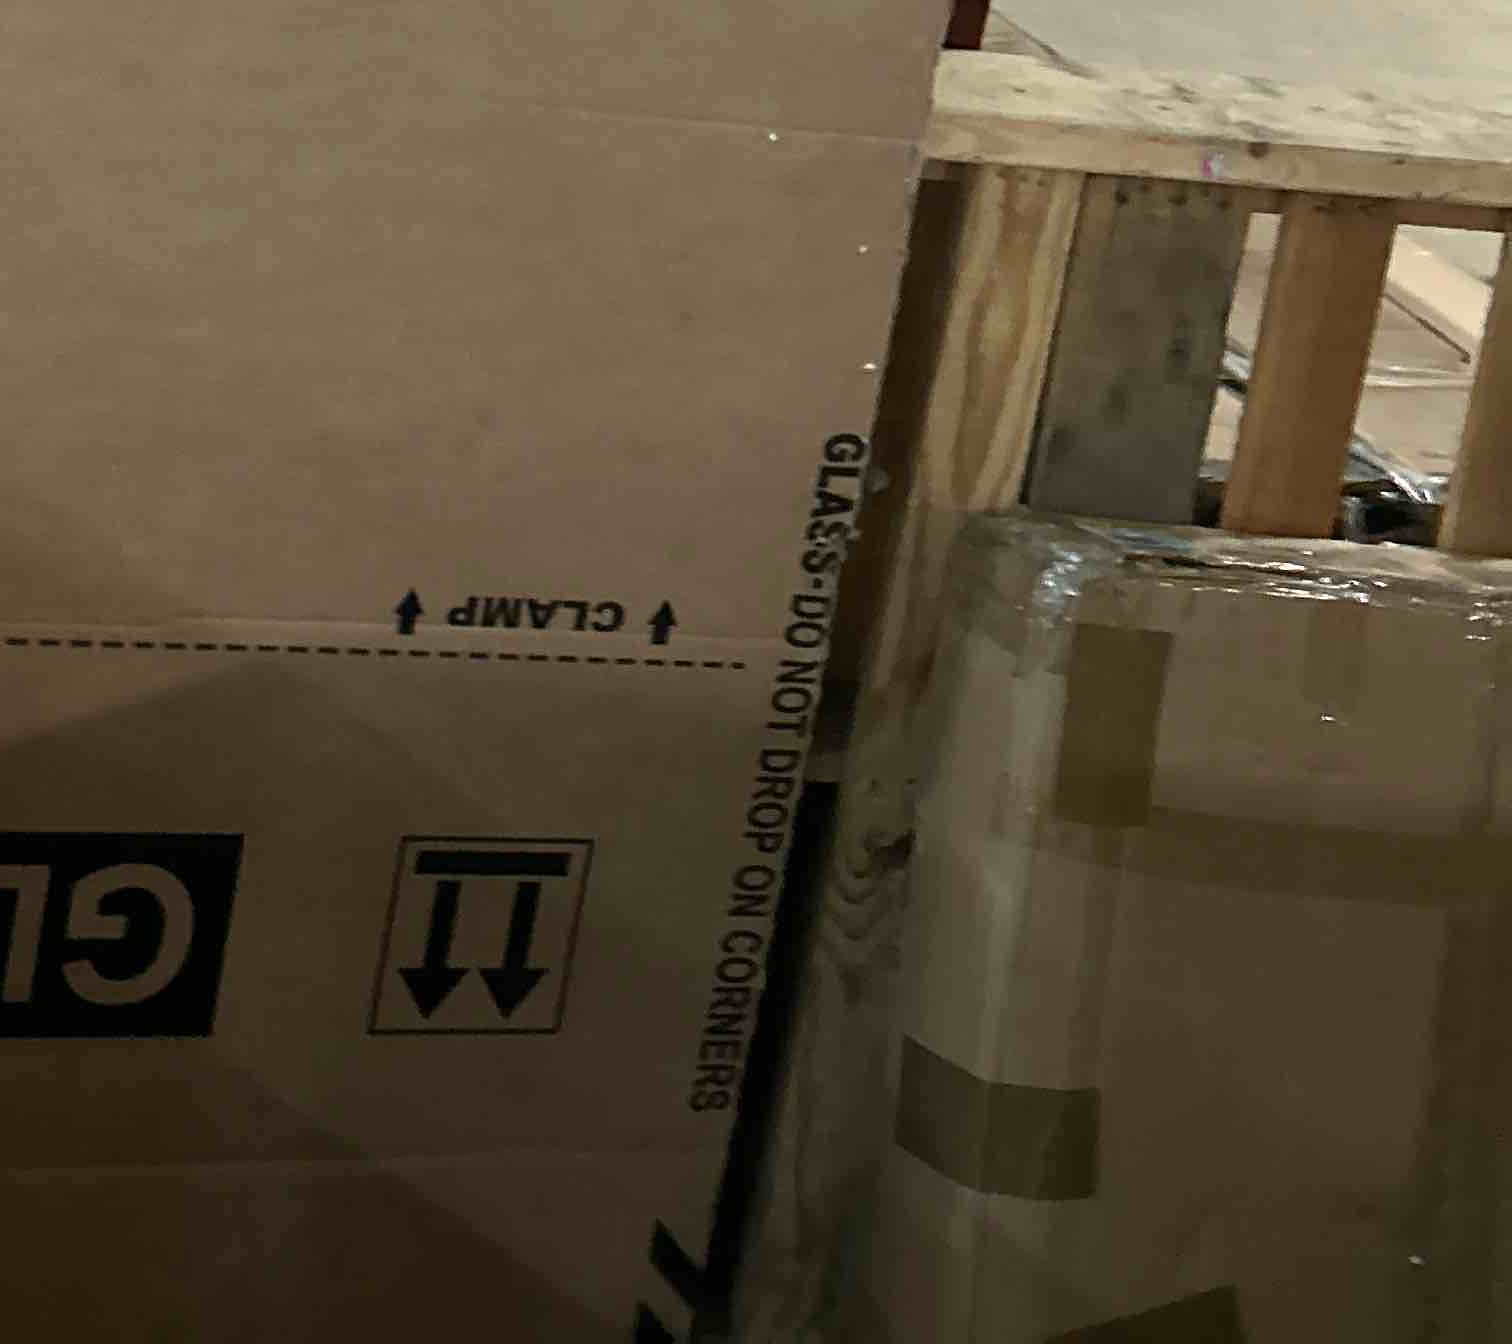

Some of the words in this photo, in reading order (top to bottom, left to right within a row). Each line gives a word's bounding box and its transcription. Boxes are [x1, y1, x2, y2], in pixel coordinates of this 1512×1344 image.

[446, 595, 626, 633] CLAMP
[766, 659, 819, 735] NOT
[744, 747, 802, 855] DROP
[726, 863, 777, 921] ON
[688, 926, 765, 1114] CORNERS
